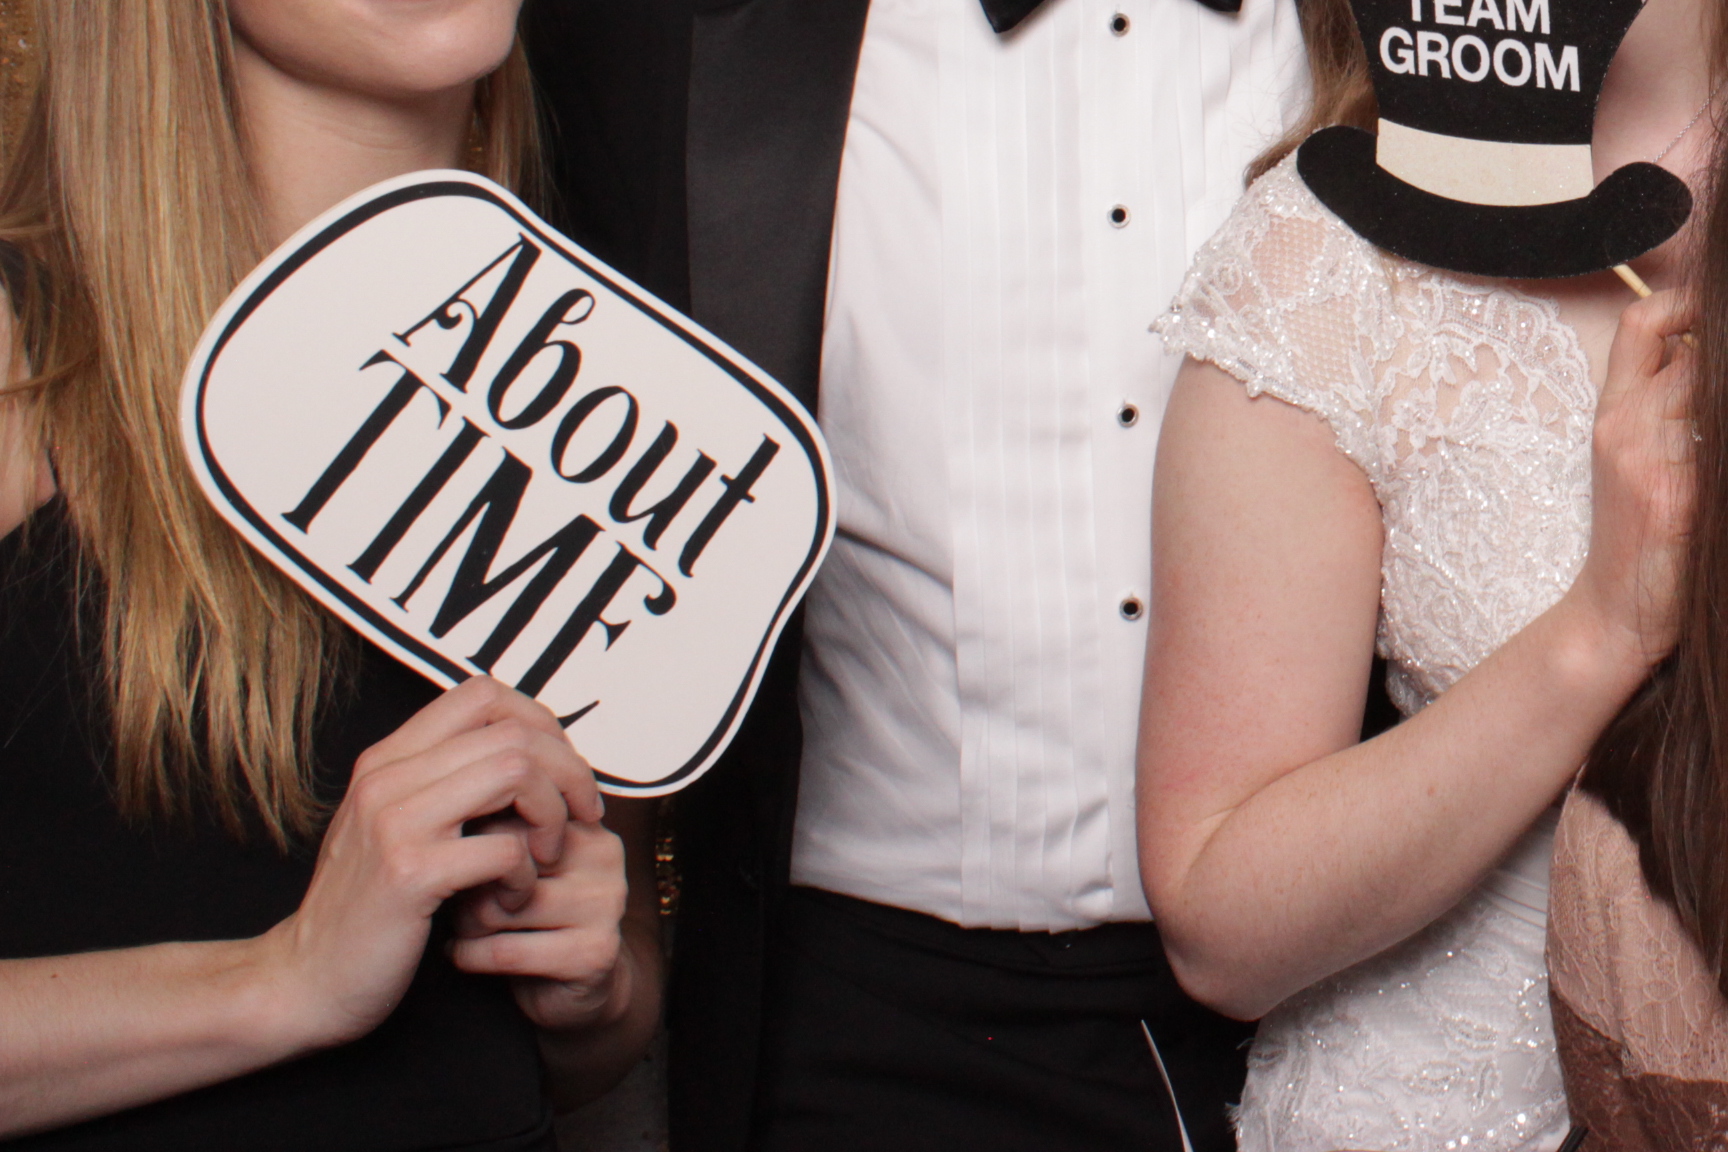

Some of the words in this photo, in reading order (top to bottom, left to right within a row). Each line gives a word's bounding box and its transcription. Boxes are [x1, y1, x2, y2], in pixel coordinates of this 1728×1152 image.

[1379, 26, 1581, 93] GROOM
[279, 348, 678, 732] TIME
[391, 232, 782, 580] About
